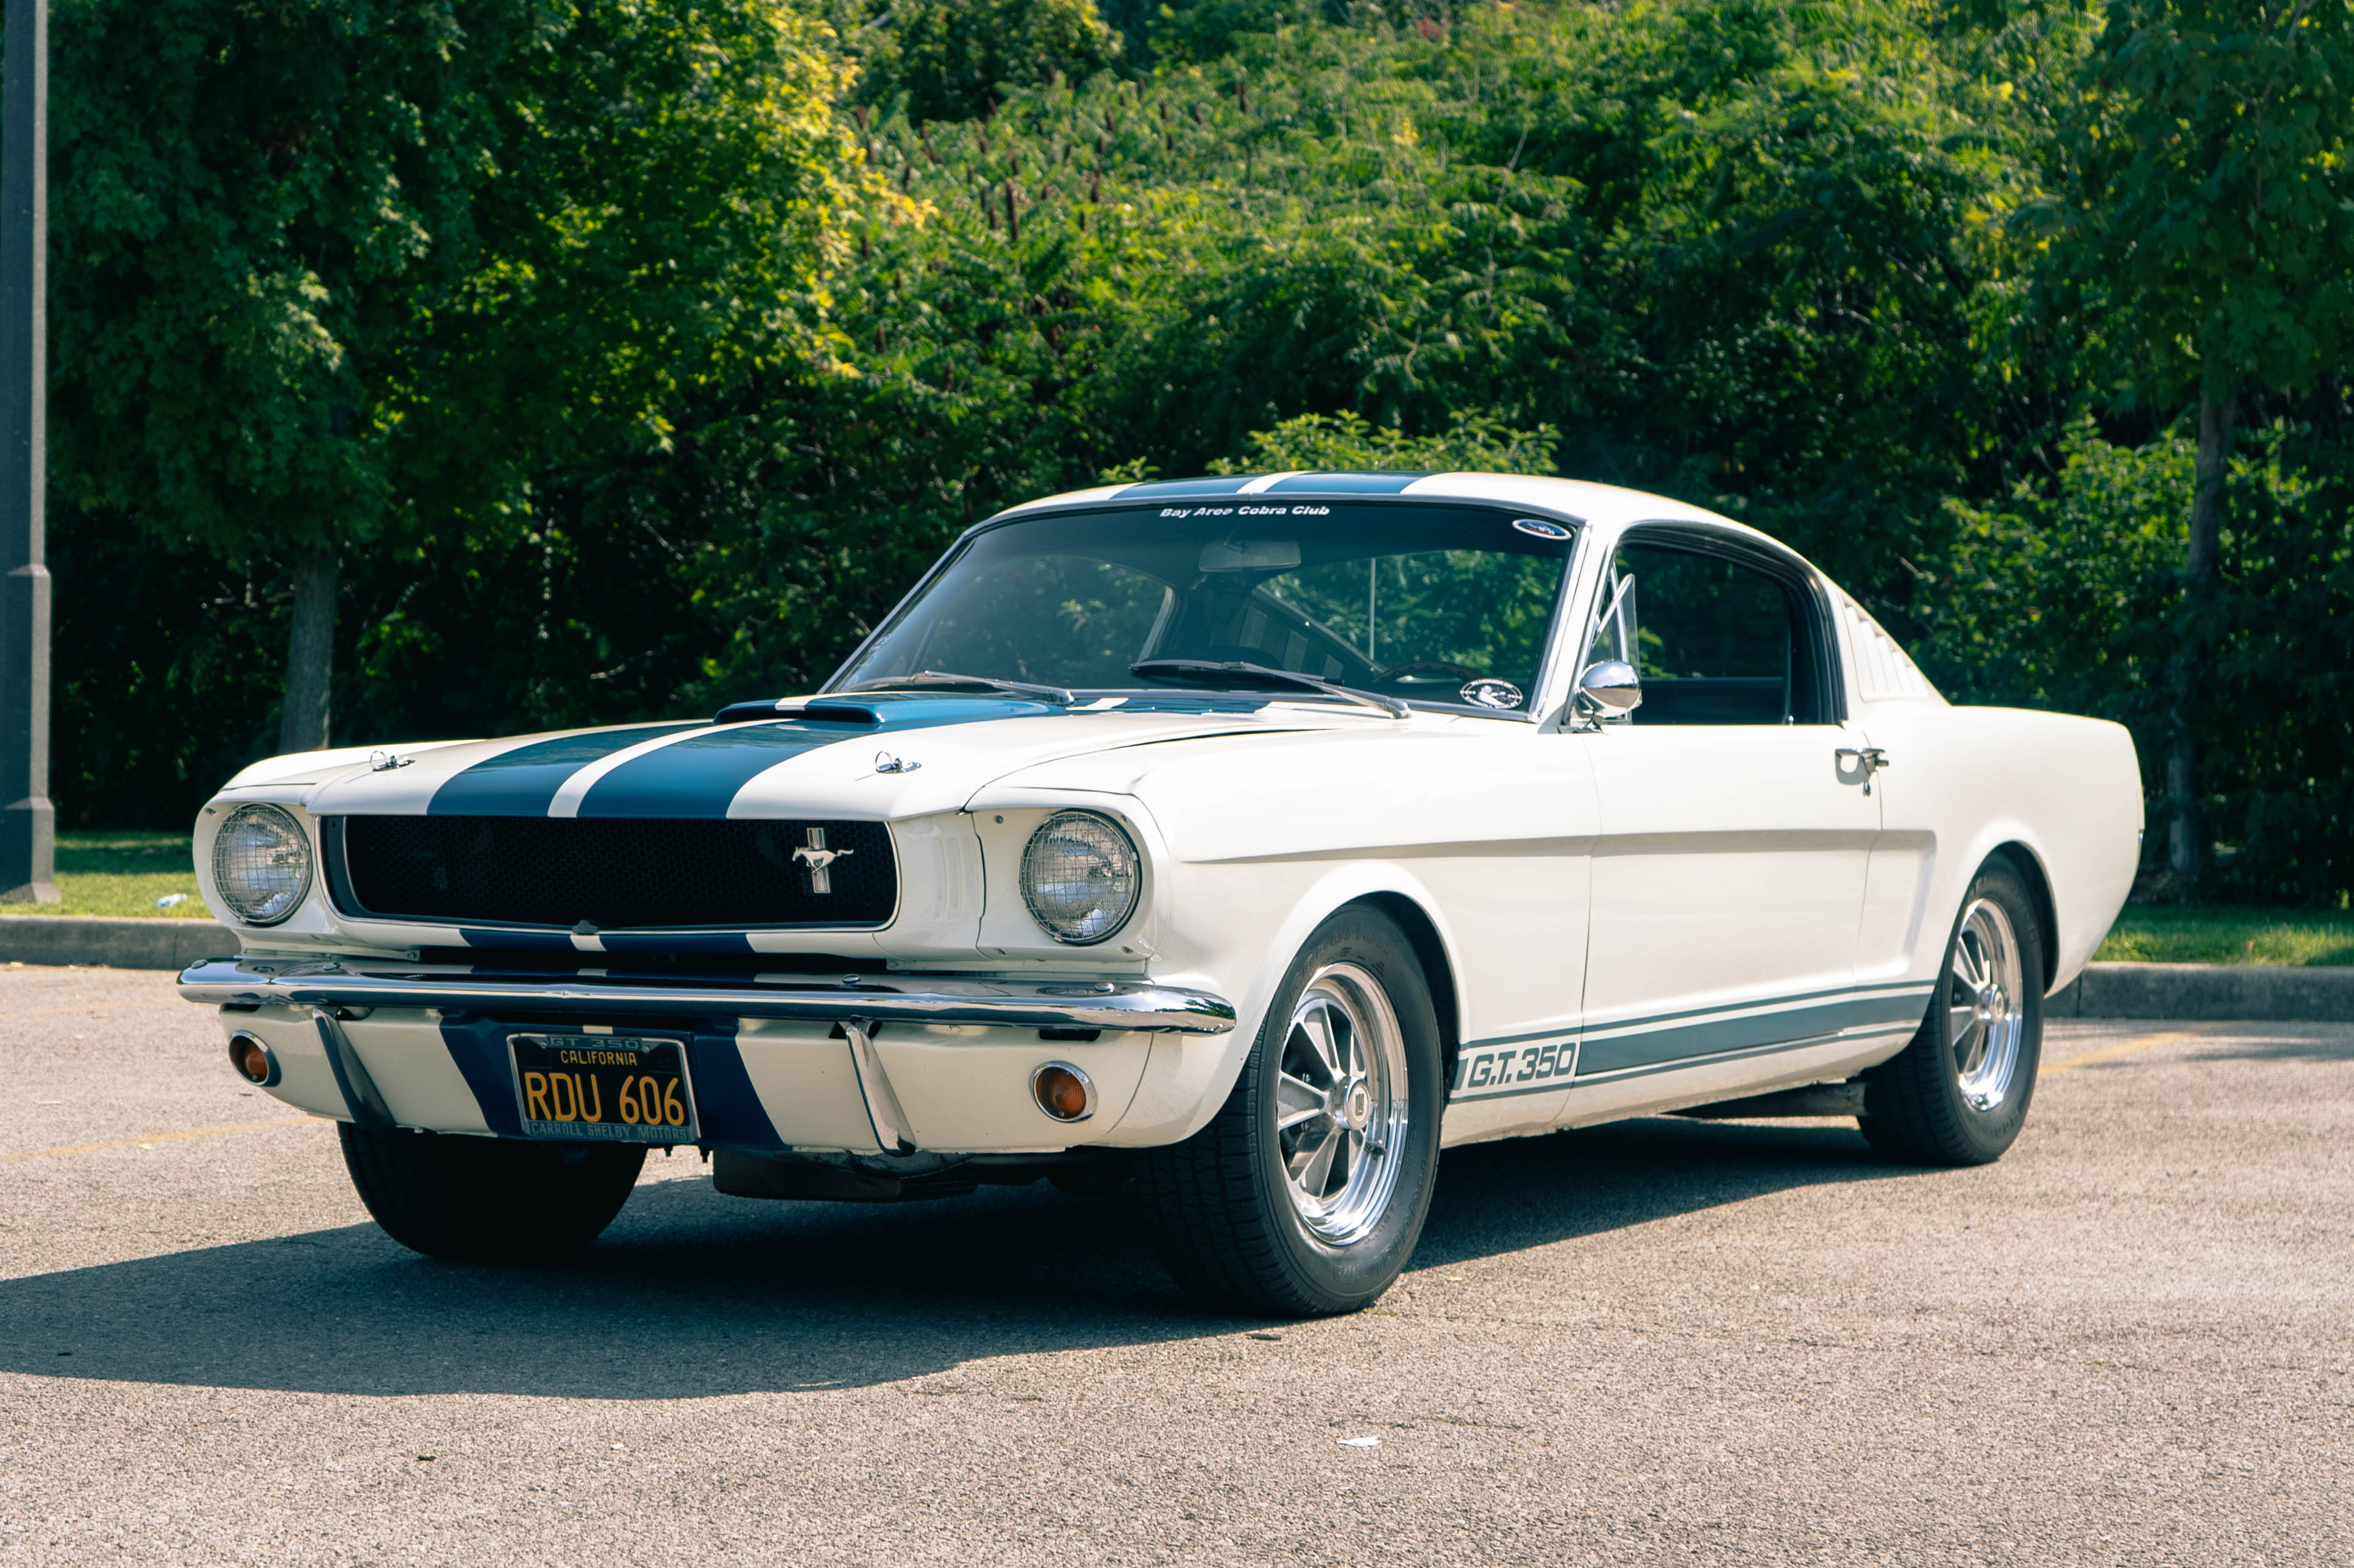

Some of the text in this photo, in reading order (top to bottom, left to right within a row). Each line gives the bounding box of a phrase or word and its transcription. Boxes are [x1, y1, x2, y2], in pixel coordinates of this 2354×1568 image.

[1159, 505, 1330, 519] Bay Area Cobra Club
[550, 1037, 639, 1049] GT 350
[560, 1049, 638, 1066] CALIFORNIA
[524, 1071, 685, 1126] RDU 606
[531, 1123, 688, 1141] CARROLL SHELBY MOTORS
